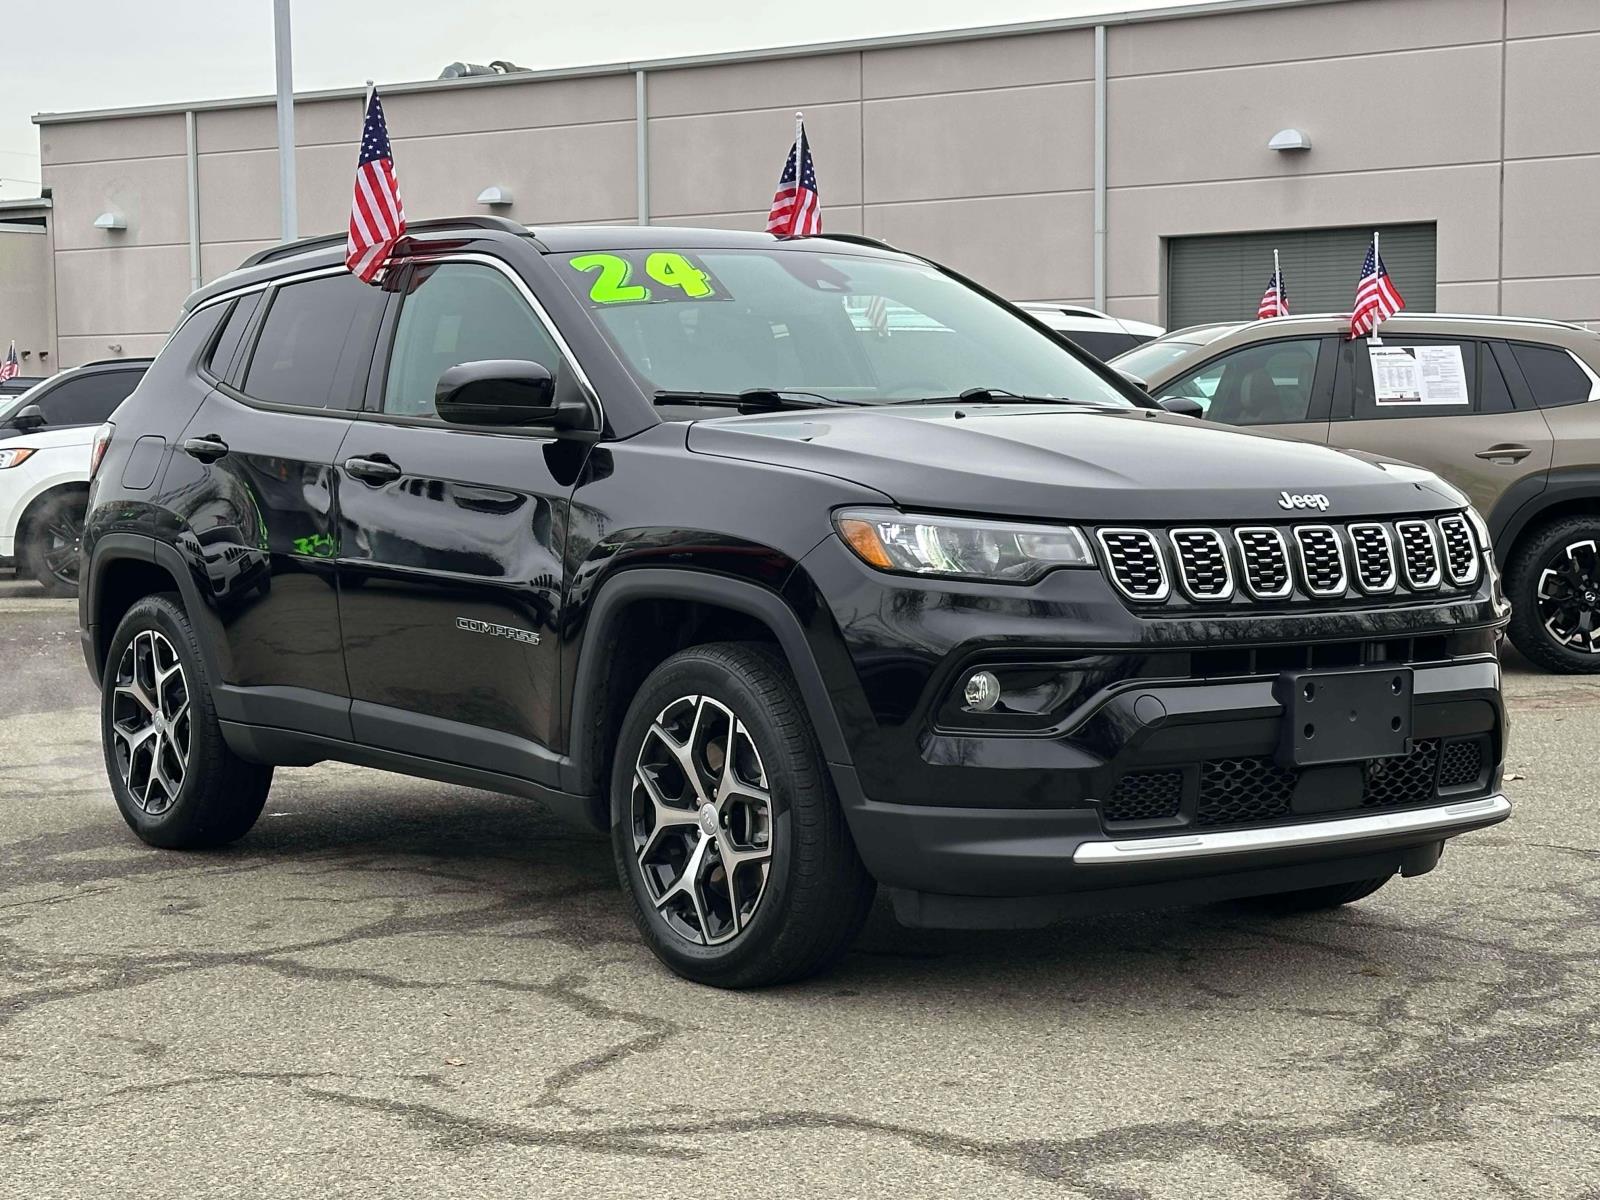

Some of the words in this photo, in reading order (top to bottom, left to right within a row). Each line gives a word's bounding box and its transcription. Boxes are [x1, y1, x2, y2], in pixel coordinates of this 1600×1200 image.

[569, 252, 712, 303] 24
[1278, 491, 1330, 512] Jeep
[456, 616, 540, 645] COMPASS
